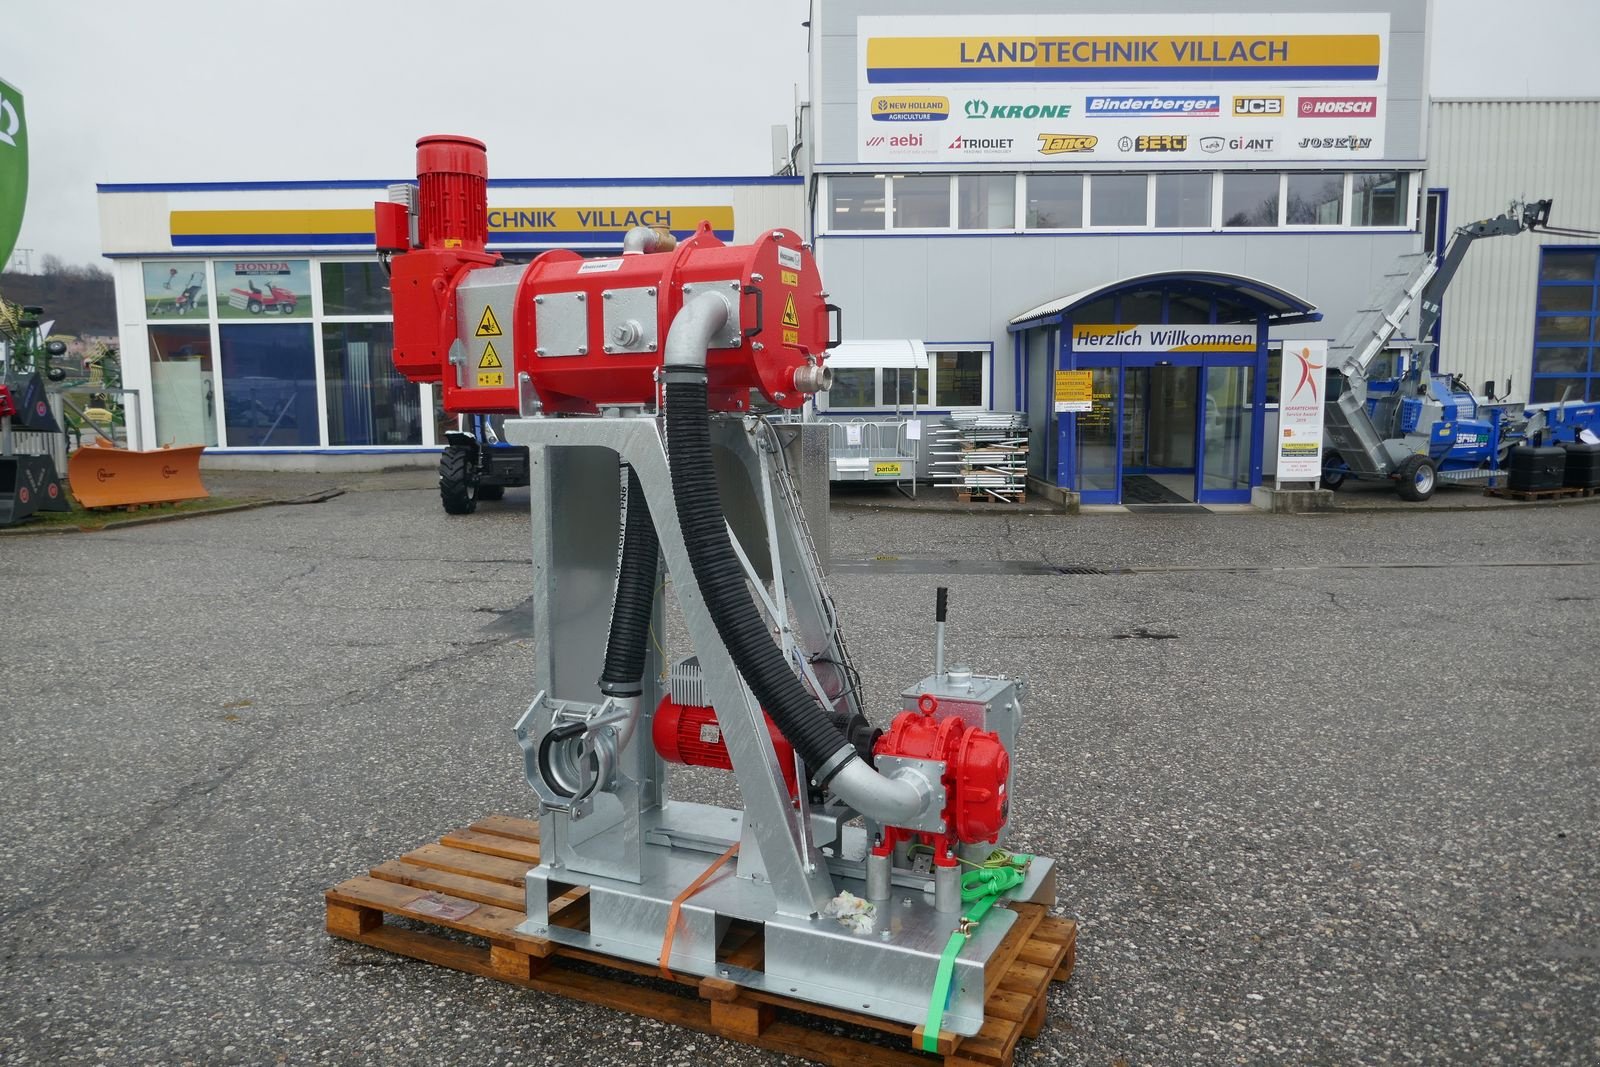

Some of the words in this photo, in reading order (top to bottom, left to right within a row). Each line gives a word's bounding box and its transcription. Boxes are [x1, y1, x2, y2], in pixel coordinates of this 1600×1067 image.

[960, 41, 1159, 63] LANDTECHNIK
[1170, 40, 1288, 62] VILLACH
[990, 105, 1072, 119] KRONE
[1089, 98, 1218, 112] Binderberger
[1236, 99, 1281, 114] JCB
[1314, 101, 1373, 113] HORSCH
[890, 134, 922, 147] aebi
[962, 138, 1014, 148] TRIOLIET
[1038, 134, 1098, 151] Tanco
[1298, 136, 1372, 150] JOSKIN
[488, 210, 557, 228] CHNIK
[577, 210, 671, 227] VILLACH
[235, 263, 289, 271] HONDA
[1077, 331, 1142, 346] Herzlich
[1150, 330, 1252, 346] Willkommen
